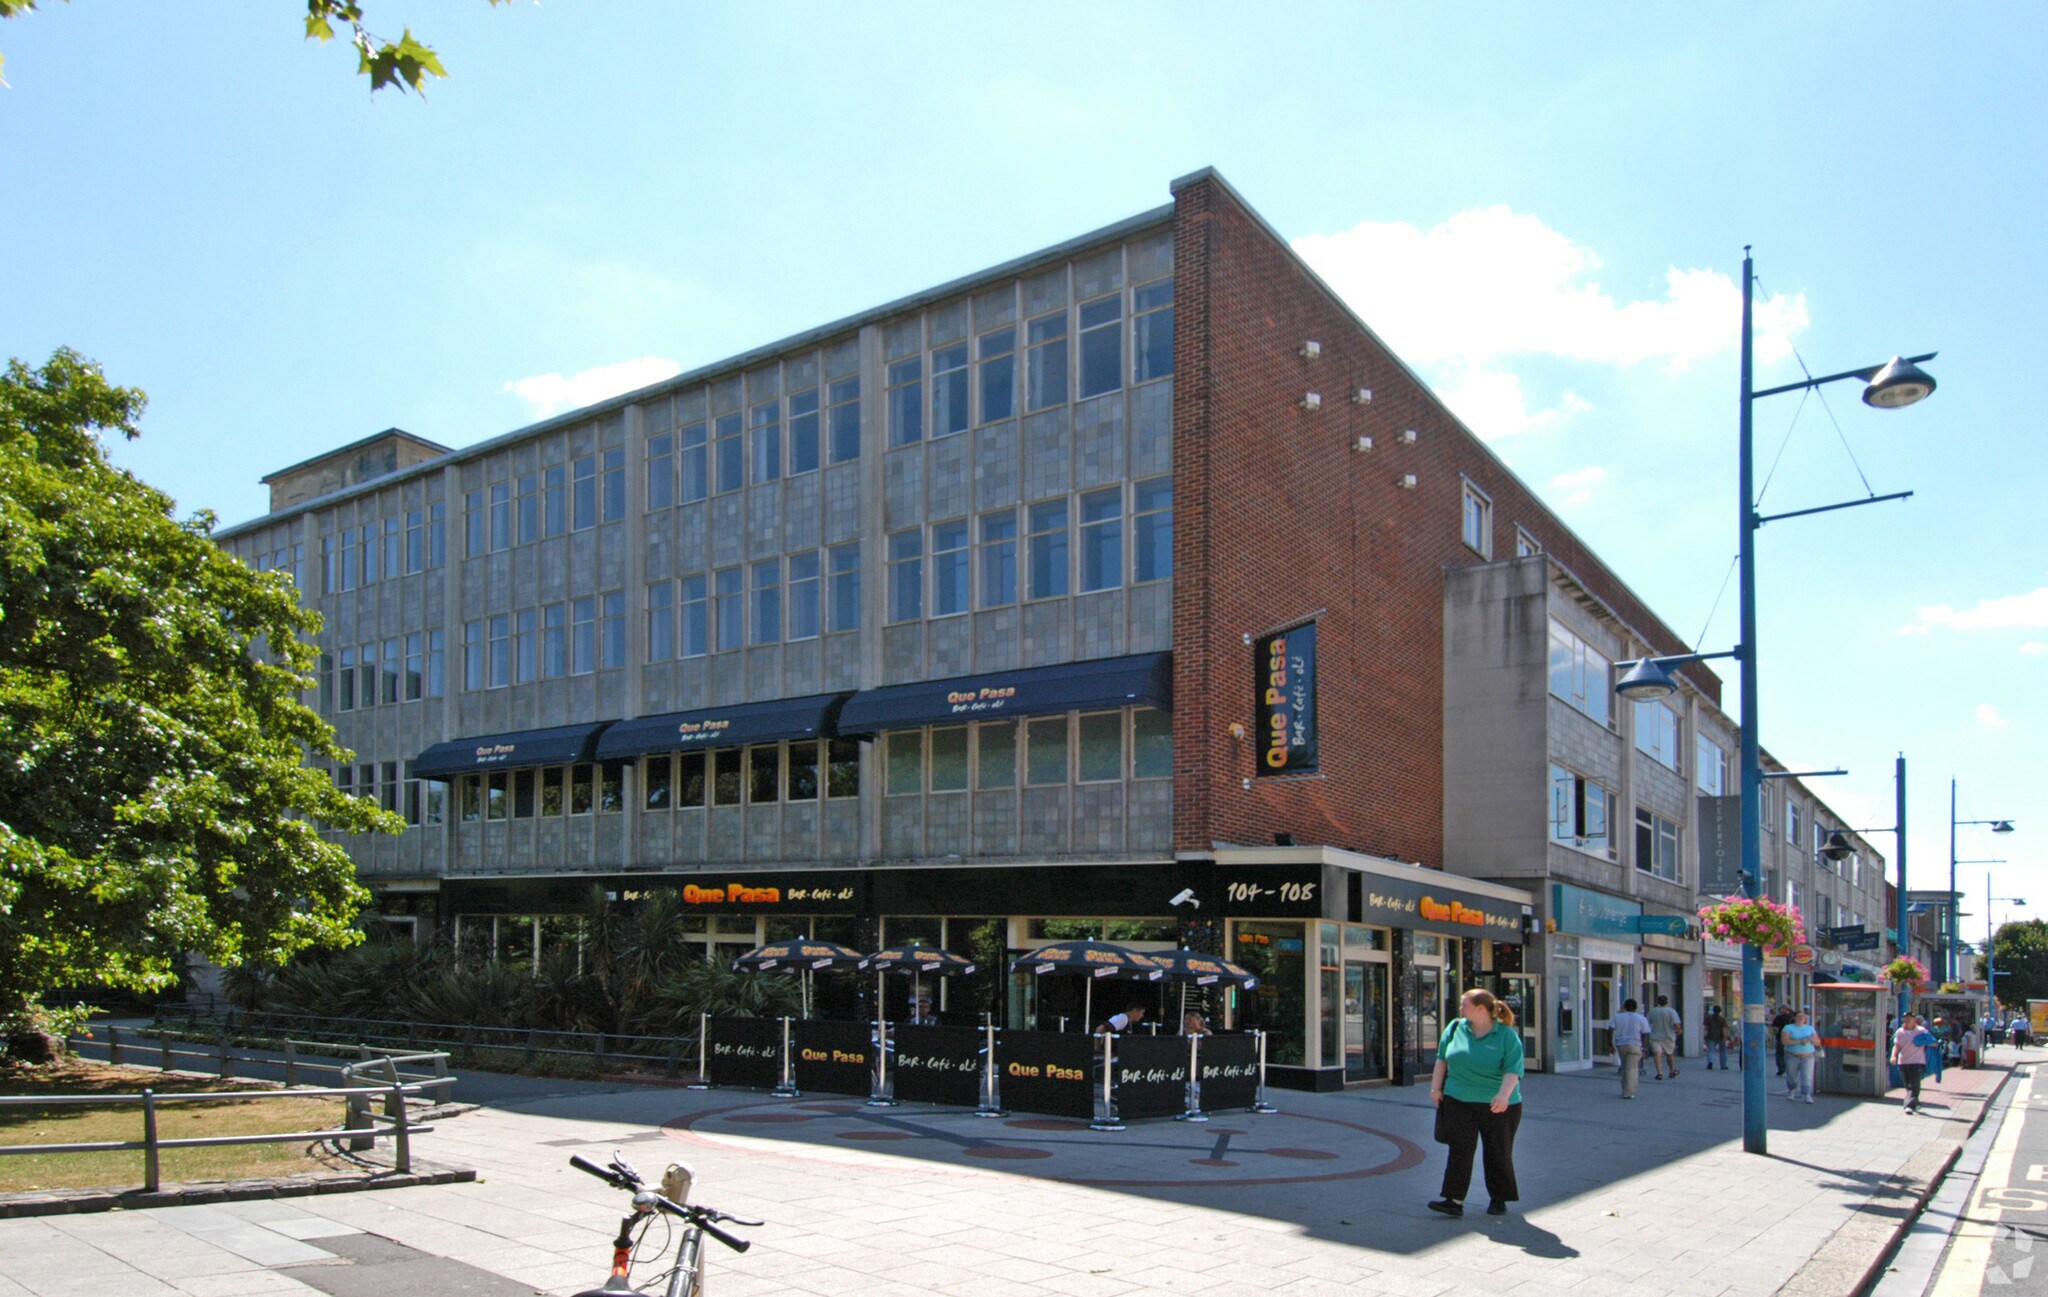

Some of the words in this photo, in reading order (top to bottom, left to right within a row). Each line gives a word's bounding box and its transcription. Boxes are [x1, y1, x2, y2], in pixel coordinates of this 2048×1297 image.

[1265, 638, 1287, 706] Pasa
[948, 692, 976, 703] Que
[980, 687, 1015, 699] Pasa
[680, 723, 701, 733] Que
[703, 720, 729, 730] Pasa
[1266, 713, 1289, 768] Que
[683, 884, 725, 904] Que
[727, 883, 780, 903] Pasa
[1420, 896, 1450, 921] Que
[1451, 901, 1484, 926] Pasa
[801, 1048, 828, 1061] Que
[833, 1050, 865, 1064] Pasa
[1008, 1062, 1040, 1077] Que
[1046, 1064, 1084, 1081] Pasa
